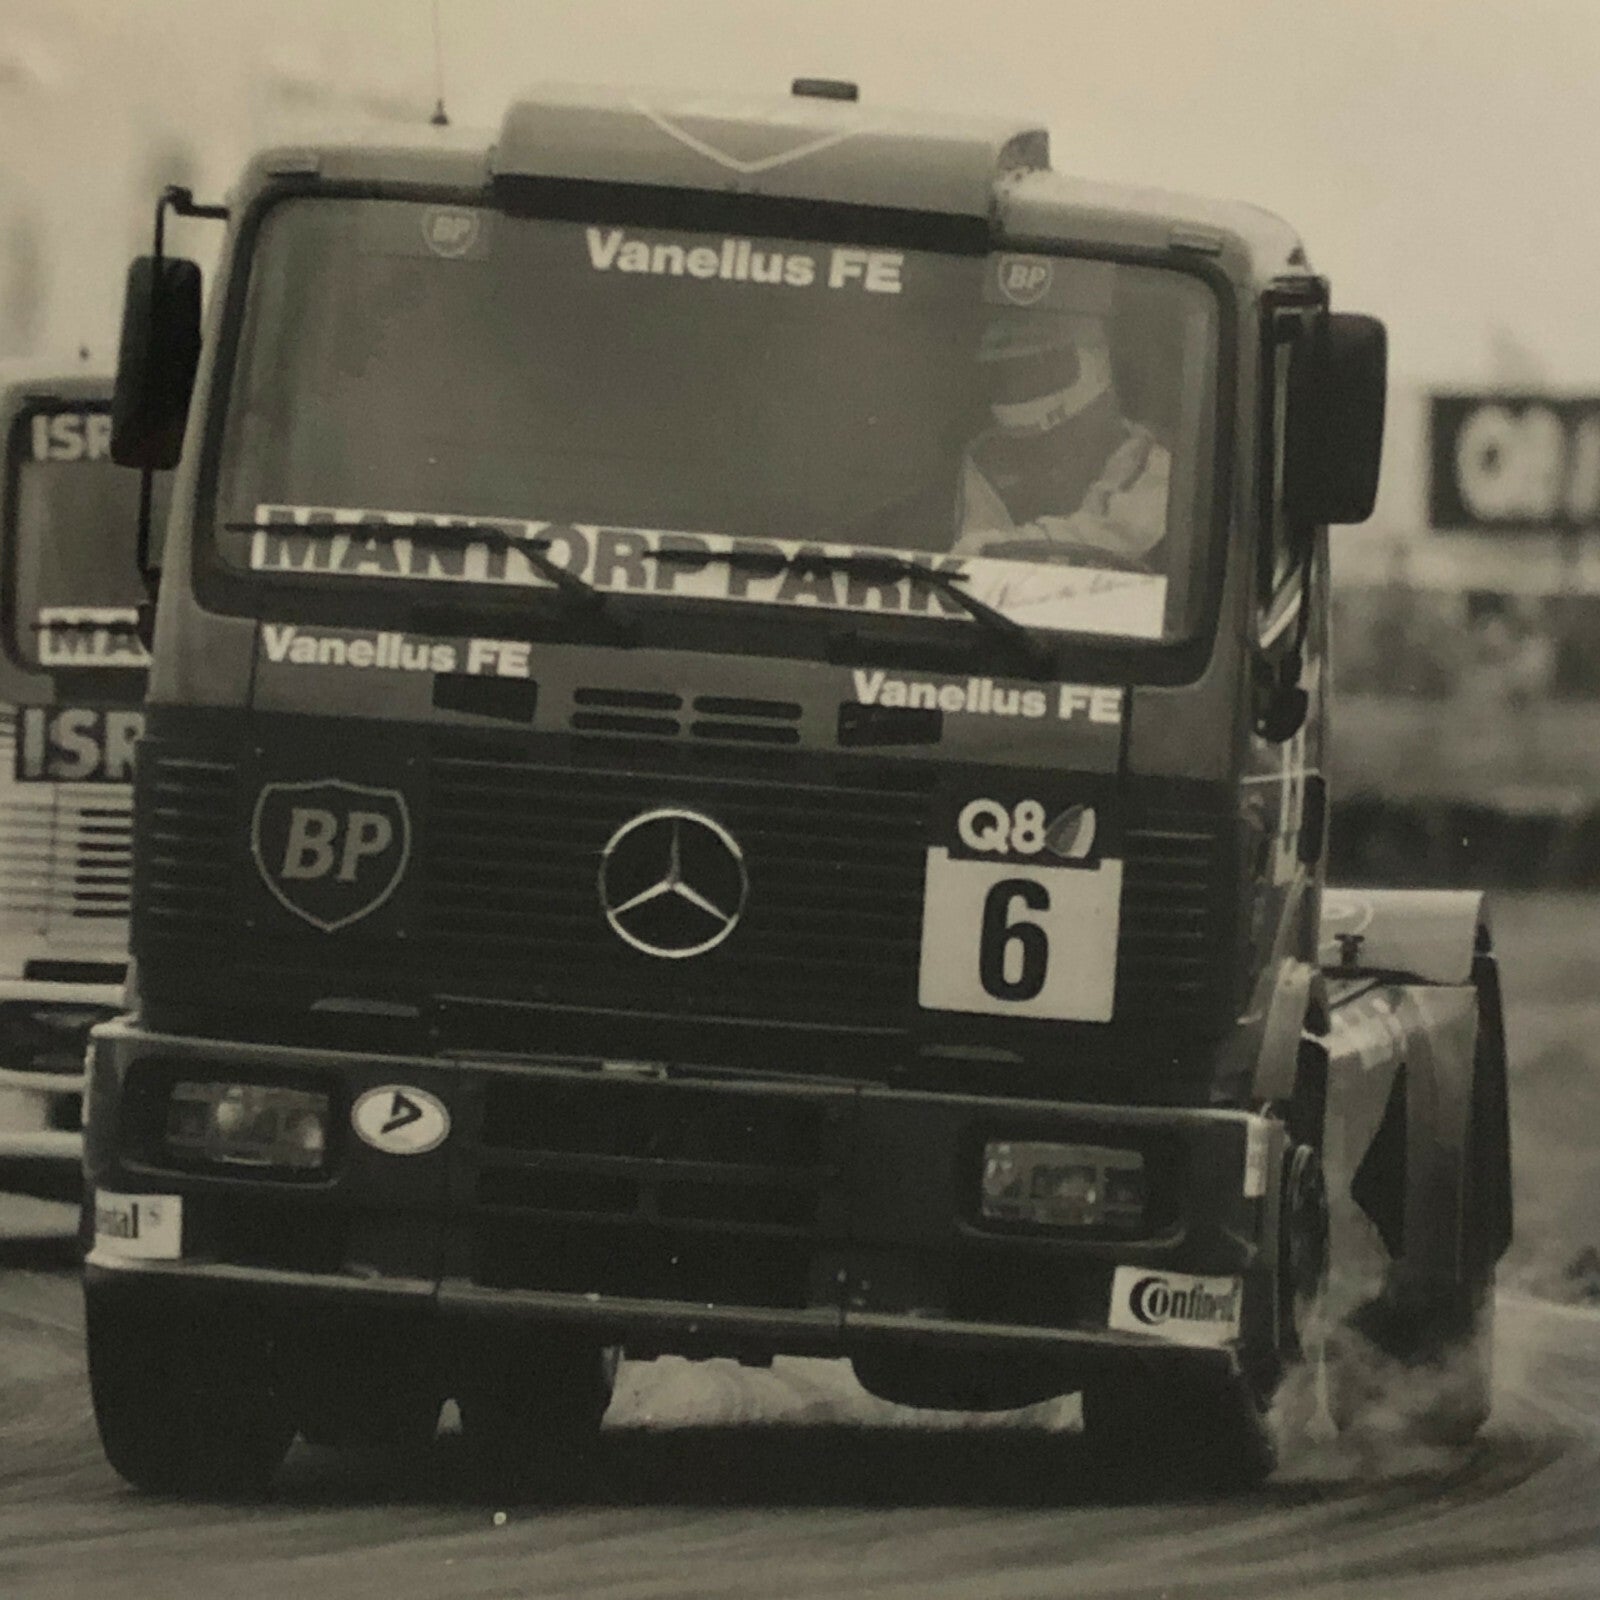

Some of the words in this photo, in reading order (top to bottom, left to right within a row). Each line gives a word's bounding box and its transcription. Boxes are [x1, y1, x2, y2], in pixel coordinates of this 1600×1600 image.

[432, 215, 471, 243] BP
[585, 226, 815, 288] Vanellus
[828, 248, 905, 294] FE
[1007, 263, 1046, 290] BP
[264, 509, 711, 591] MANTORP
[727, 539, 974, 614] PARK
[262, 623, 458, 672] Vanellus
[464, 637, 533, 679] FE
[853, 668, 1047, 718] Vanellus
[1058, 684, 1124, 724] FE
[281, 807, 393, 882] BP
[957, 797, 1047, 855] Q8
[978, 878, 1051, 1002] 6
